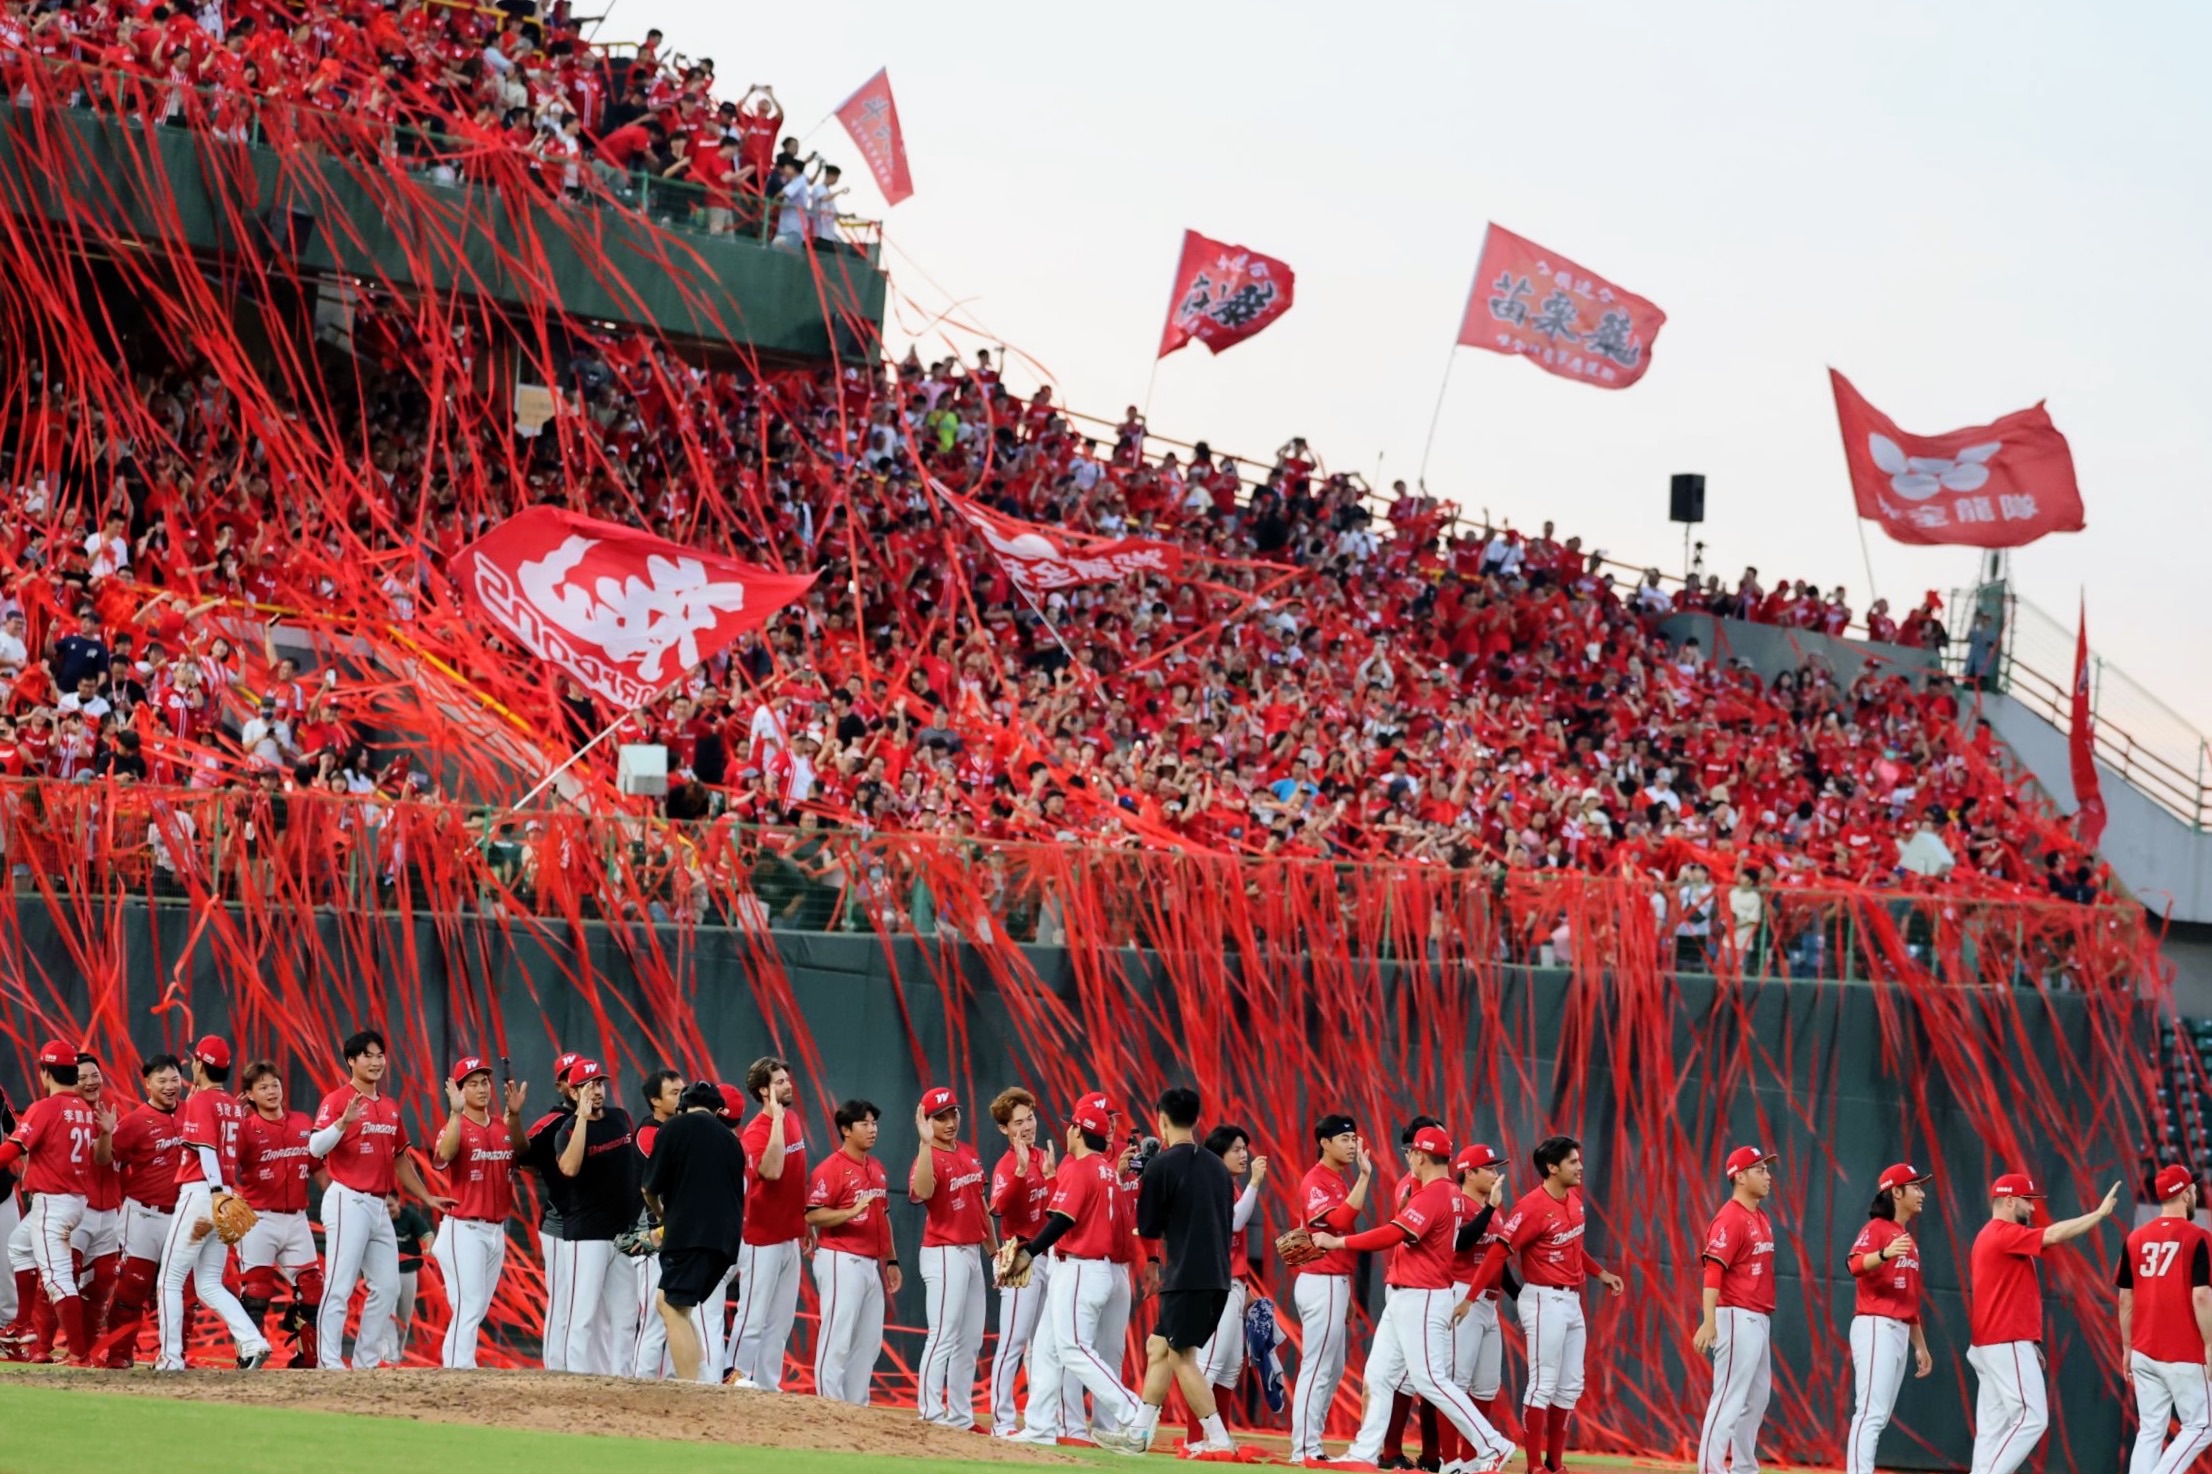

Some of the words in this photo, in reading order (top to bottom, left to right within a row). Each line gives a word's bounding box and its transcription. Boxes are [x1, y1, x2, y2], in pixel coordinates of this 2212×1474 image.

[465, 1059, 480, 1070] W
[562, 1054, 577, 1067] W
[584, 1063, 597, 1074] W
[935, 1091, 950, 1104] W
[2139, 1241, 2181, 1278] 37
